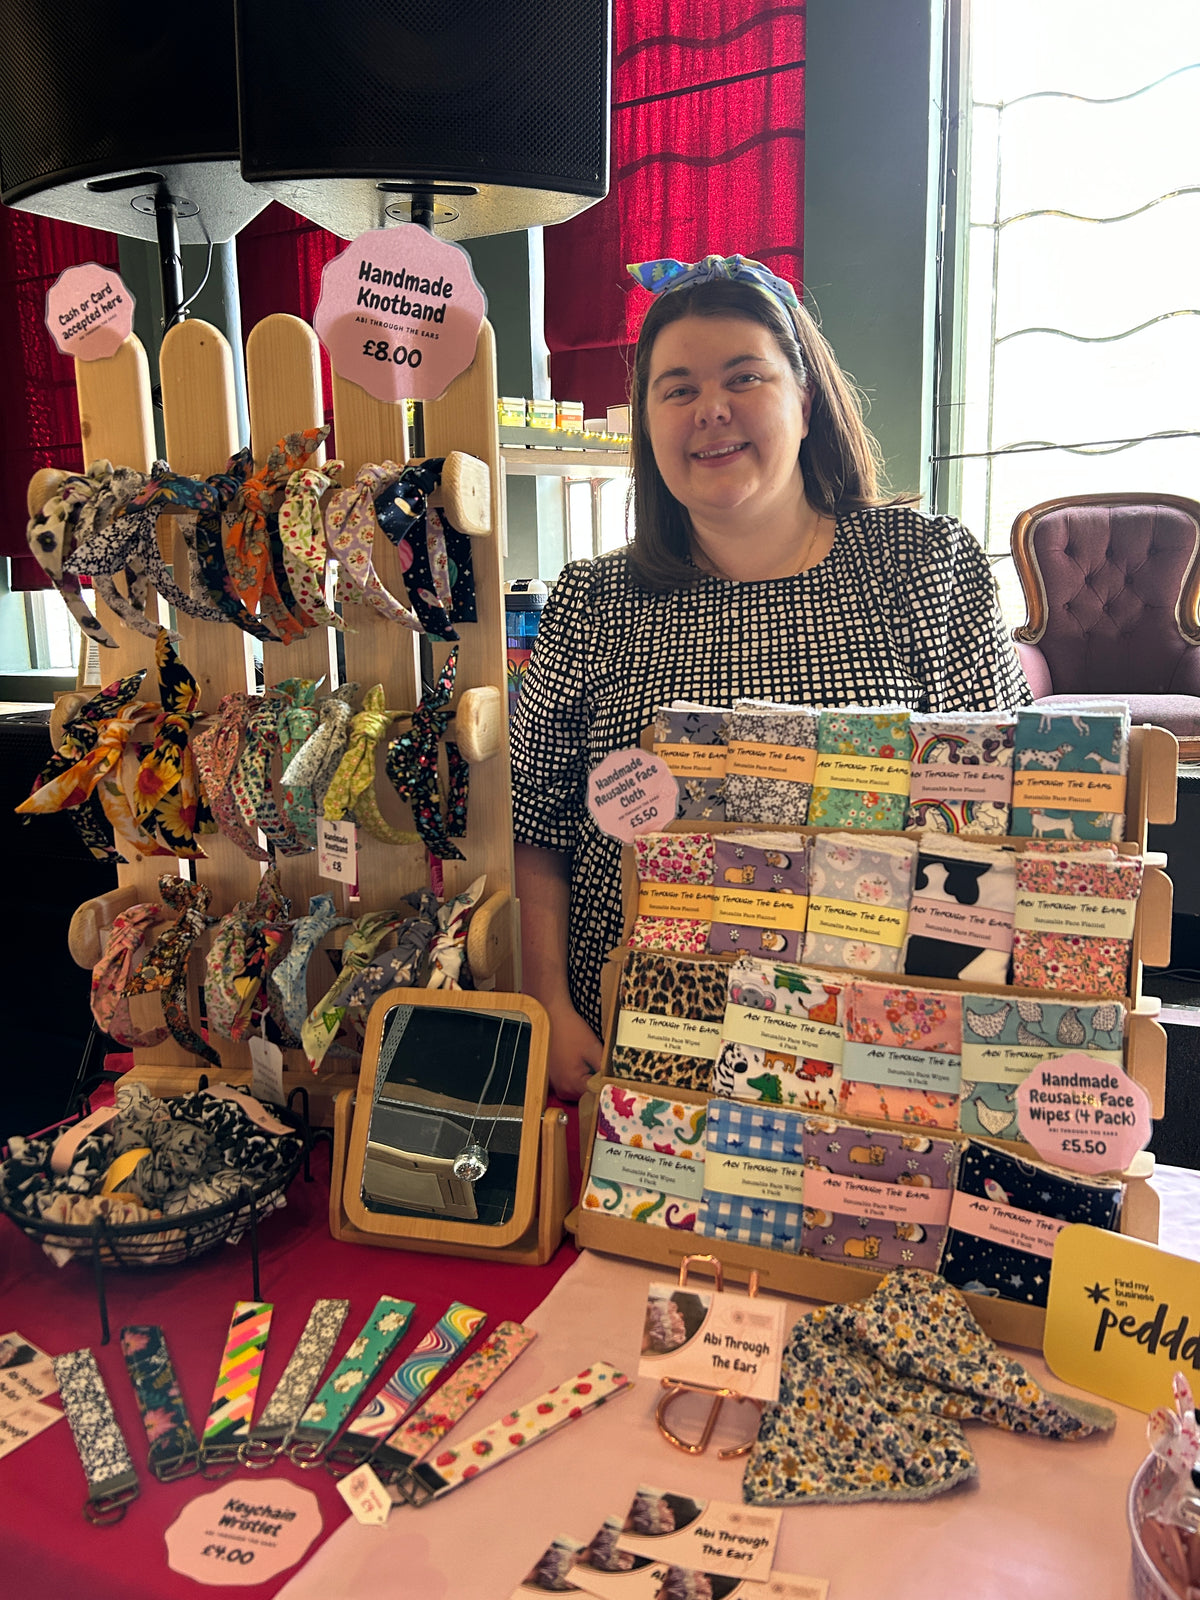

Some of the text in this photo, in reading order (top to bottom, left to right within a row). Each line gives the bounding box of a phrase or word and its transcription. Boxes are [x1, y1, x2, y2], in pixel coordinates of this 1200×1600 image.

[359, 261, 452, 298] Handmade
[59, 282, 112, 325] Cash or Card
[357, 286, 446, 323] Knotband
[62, 307, 101, 339] accepted
[101, 295, 122, 313] here
[370, 320, 403, 331] THROUGH
[421, 331, 439, 340] EARS
[362, 340, 422, 368] £8.00
[595, 758, 642, 790] Handmade
[595, 765, 658, 807] Reusable Face
[620, 788, 646, 807] Cloth
[630, 806, 658, 828] £5.50
[1042, 1072, 1119, 1088] Handmade
[1030, 1089, 1134, 1107] Reusable Face
[1030, 1107, 1136, 1126] Wipes (4 Pack)
[1062, 1139, 1106, 1155] £5.50
[1114, 1278, 1149, 1293] Find my
[1115, 1288, 1154, 1302] business
[1116, 1299, 1128, 1308] on
[704, 1332, 770, 1357] Abi Through
[712, 1355, 757, 1374] The Ears
[223, 1498, 296, 1522] Keychain
[218, 1514, 282, 1537] Wristlet
[694, 1527, 770, 1549] Abi Through
[201, 1544, 254, 1565] £4.00
[702, 1545, 753, 1561] The Ears
